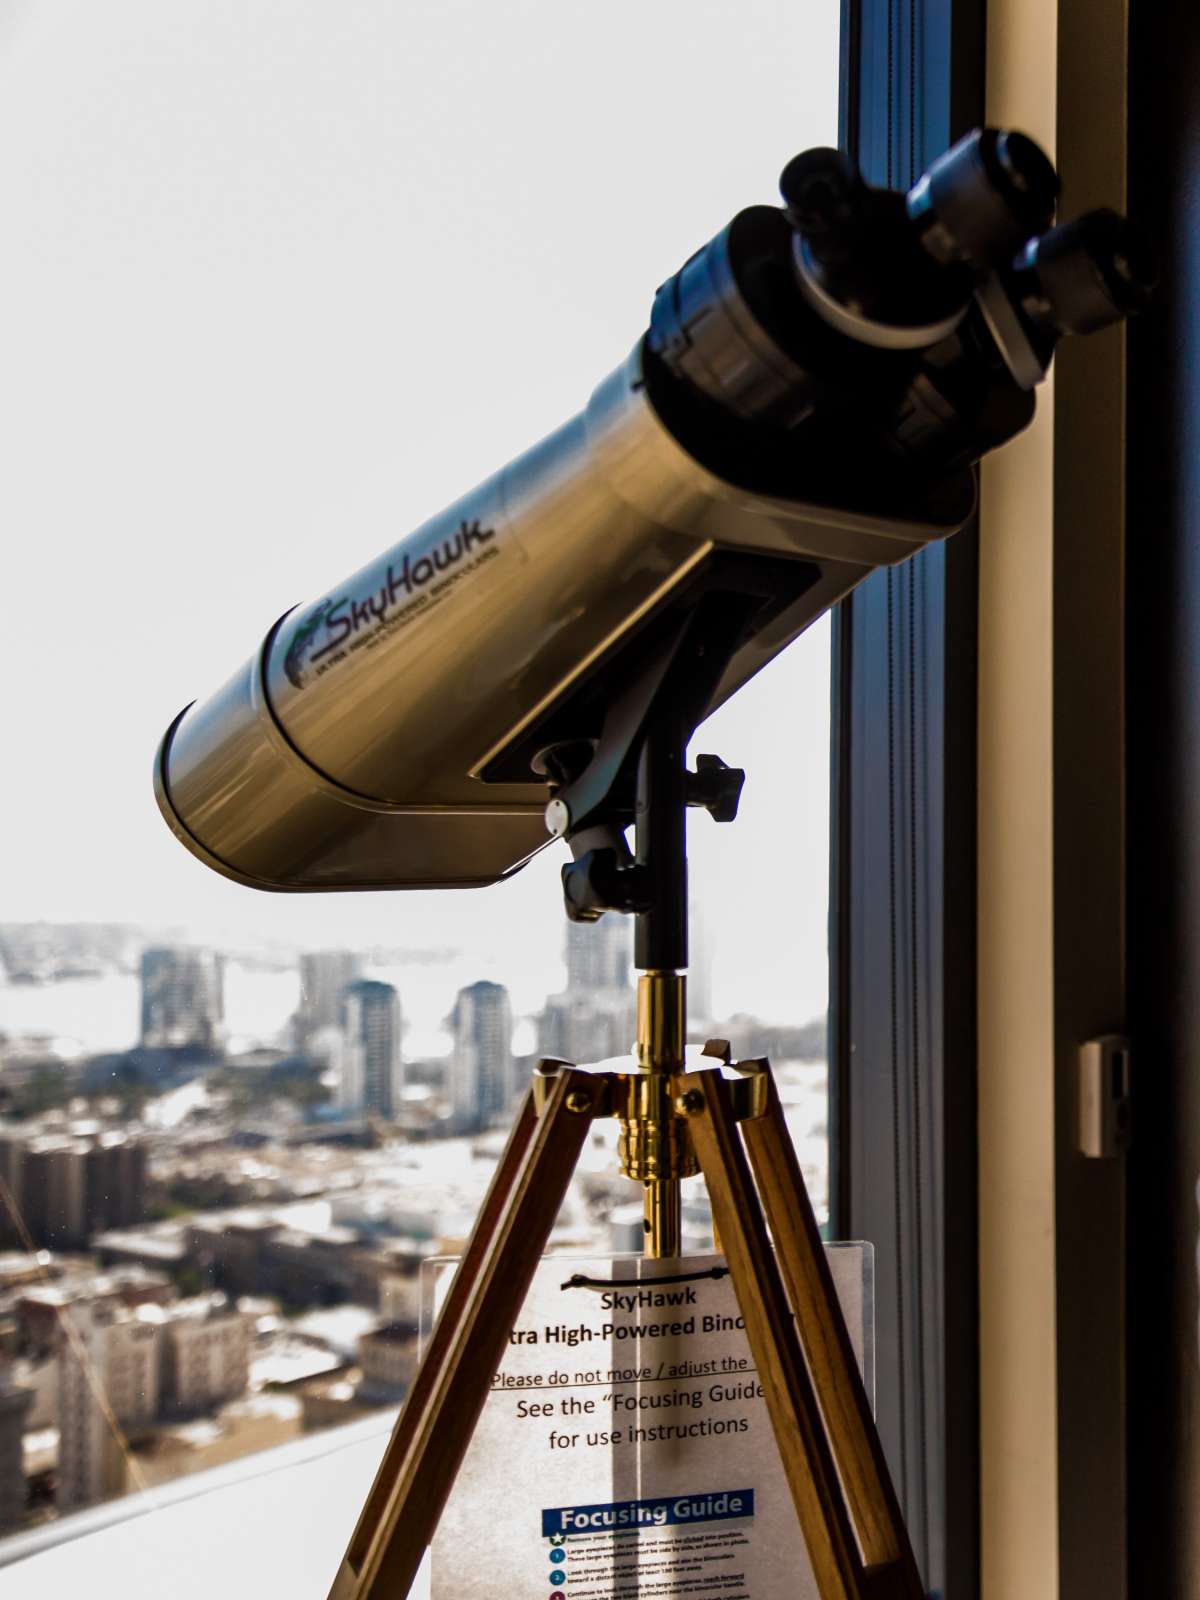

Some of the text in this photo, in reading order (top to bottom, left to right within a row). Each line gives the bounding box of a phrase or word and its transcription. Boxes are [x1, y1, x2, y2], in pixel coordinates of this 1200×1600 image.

[310, 517, 494, 662] SkyHawk
[601, 1287, 696, 1313] SkyHawk
[509, 1328, 538, 1345] tra
[545, 1315, 695, 1347] High-Powered
[491, 1356, 748, 1387] Please do not move / adjust the
[516, 1401, 554, 1418] See
[561, 1397, 595, 1415] the
[602, 1388, 703, 1412] “Focusing
[549, 1417, 749, 1449] for use instructions
[561, 1494, 743, 1529] Focusing Guide
